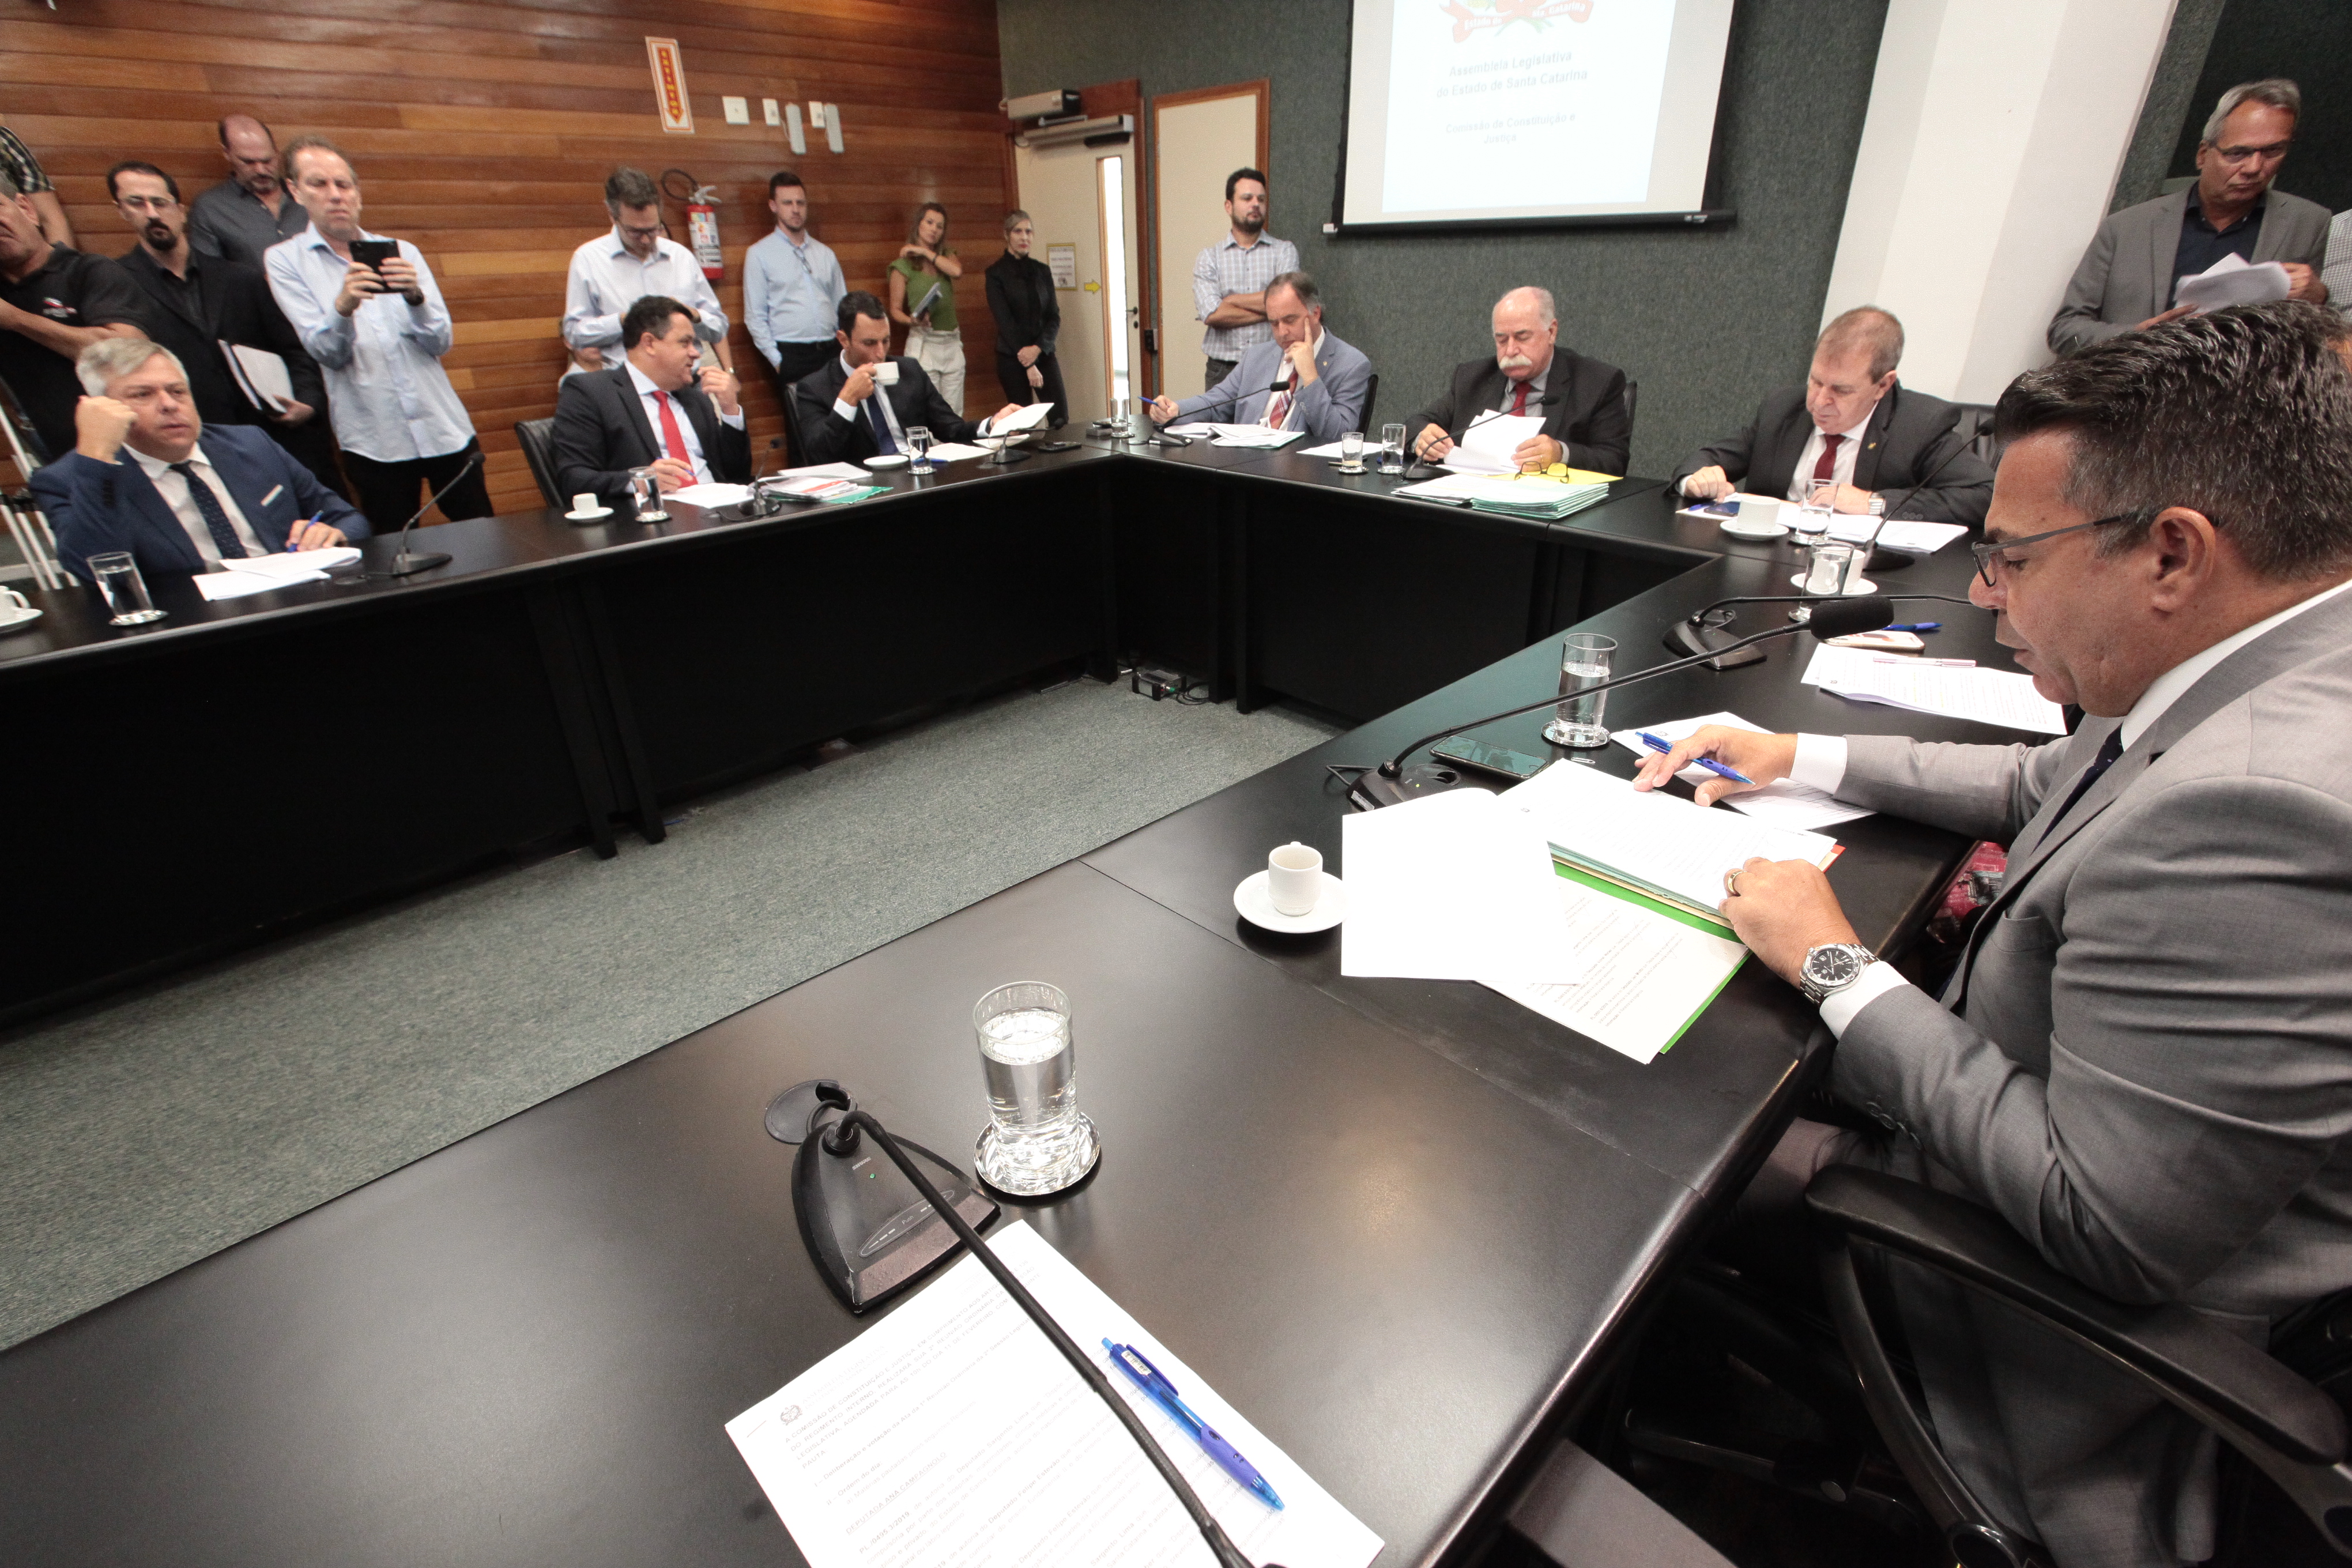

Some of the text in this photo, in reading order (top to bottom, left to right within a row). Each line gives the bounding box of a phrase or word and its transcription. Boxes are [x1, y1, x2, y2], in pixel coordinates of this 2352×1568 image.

[1449, 50, 1573, 77] Assembleia Legislativa
[1437, 69, 1588, 97] do Estado de Santa Catarina
[1446, 112, 1576, 133] Comissão de Constituição e
[1484, 133, 1517, 144] Justiça
[902, 1216, 914, 1225] Push
[827, 1404, 838, 1413] DE
[956, 1449, 985, 1473] Deputado
[1014, 1411, 1029, 1424] Lima
[846, 1502, 885, 1536] DEPUTADA
[885, 1490, 901, 1506] ANA
[987, 1497, 1017, 1524] Deputado
